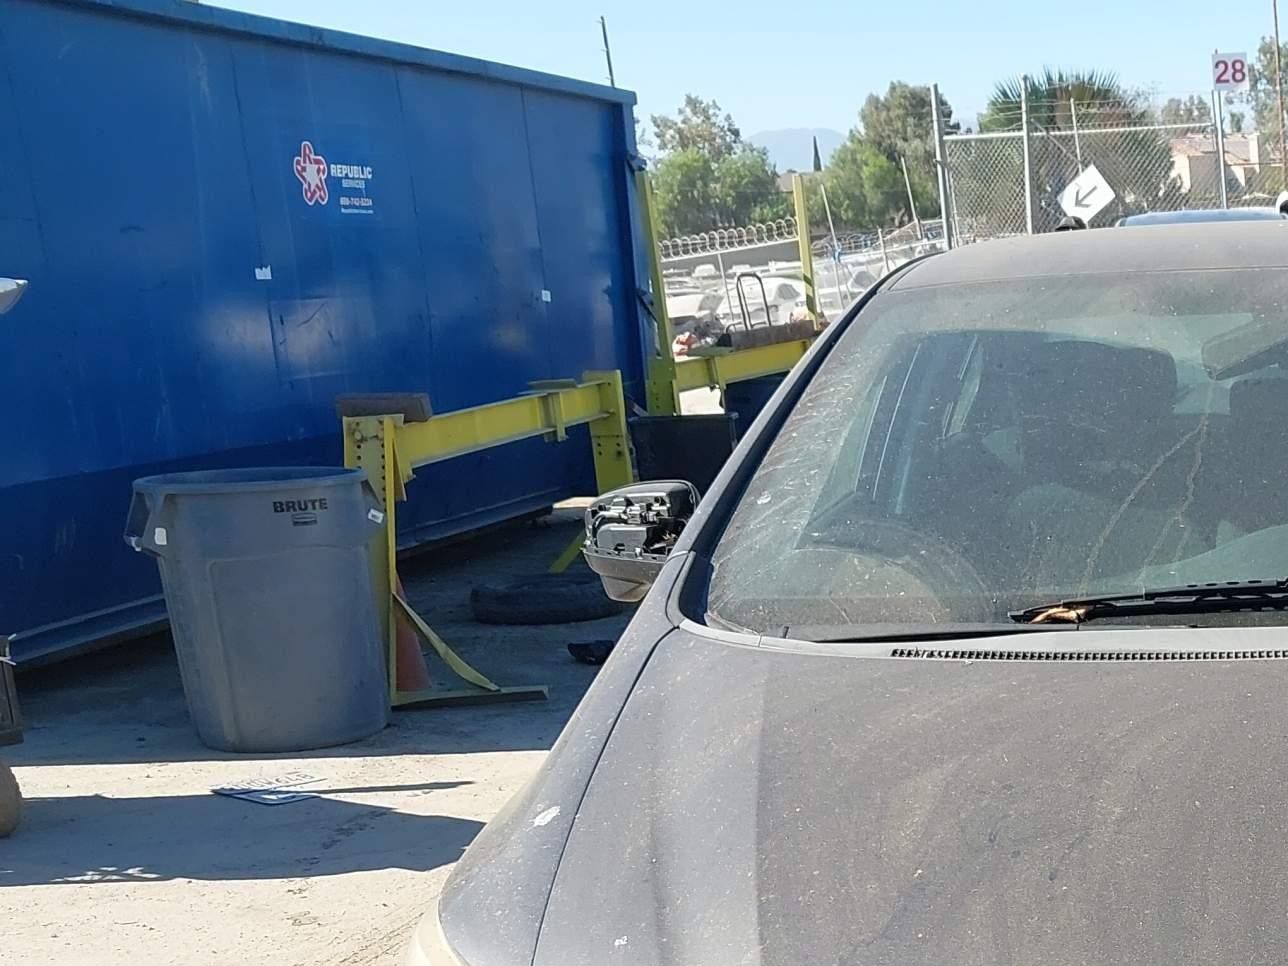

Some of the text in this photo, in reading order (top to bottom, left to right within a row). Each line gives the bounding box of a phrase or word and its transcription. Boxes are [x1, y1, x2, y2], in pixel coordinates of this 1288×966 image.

[1215, 59, 1246, 84] 28
[330, 164, 372, 179] REPUBLIC
[272, 498, 328, 513] BRUTE
